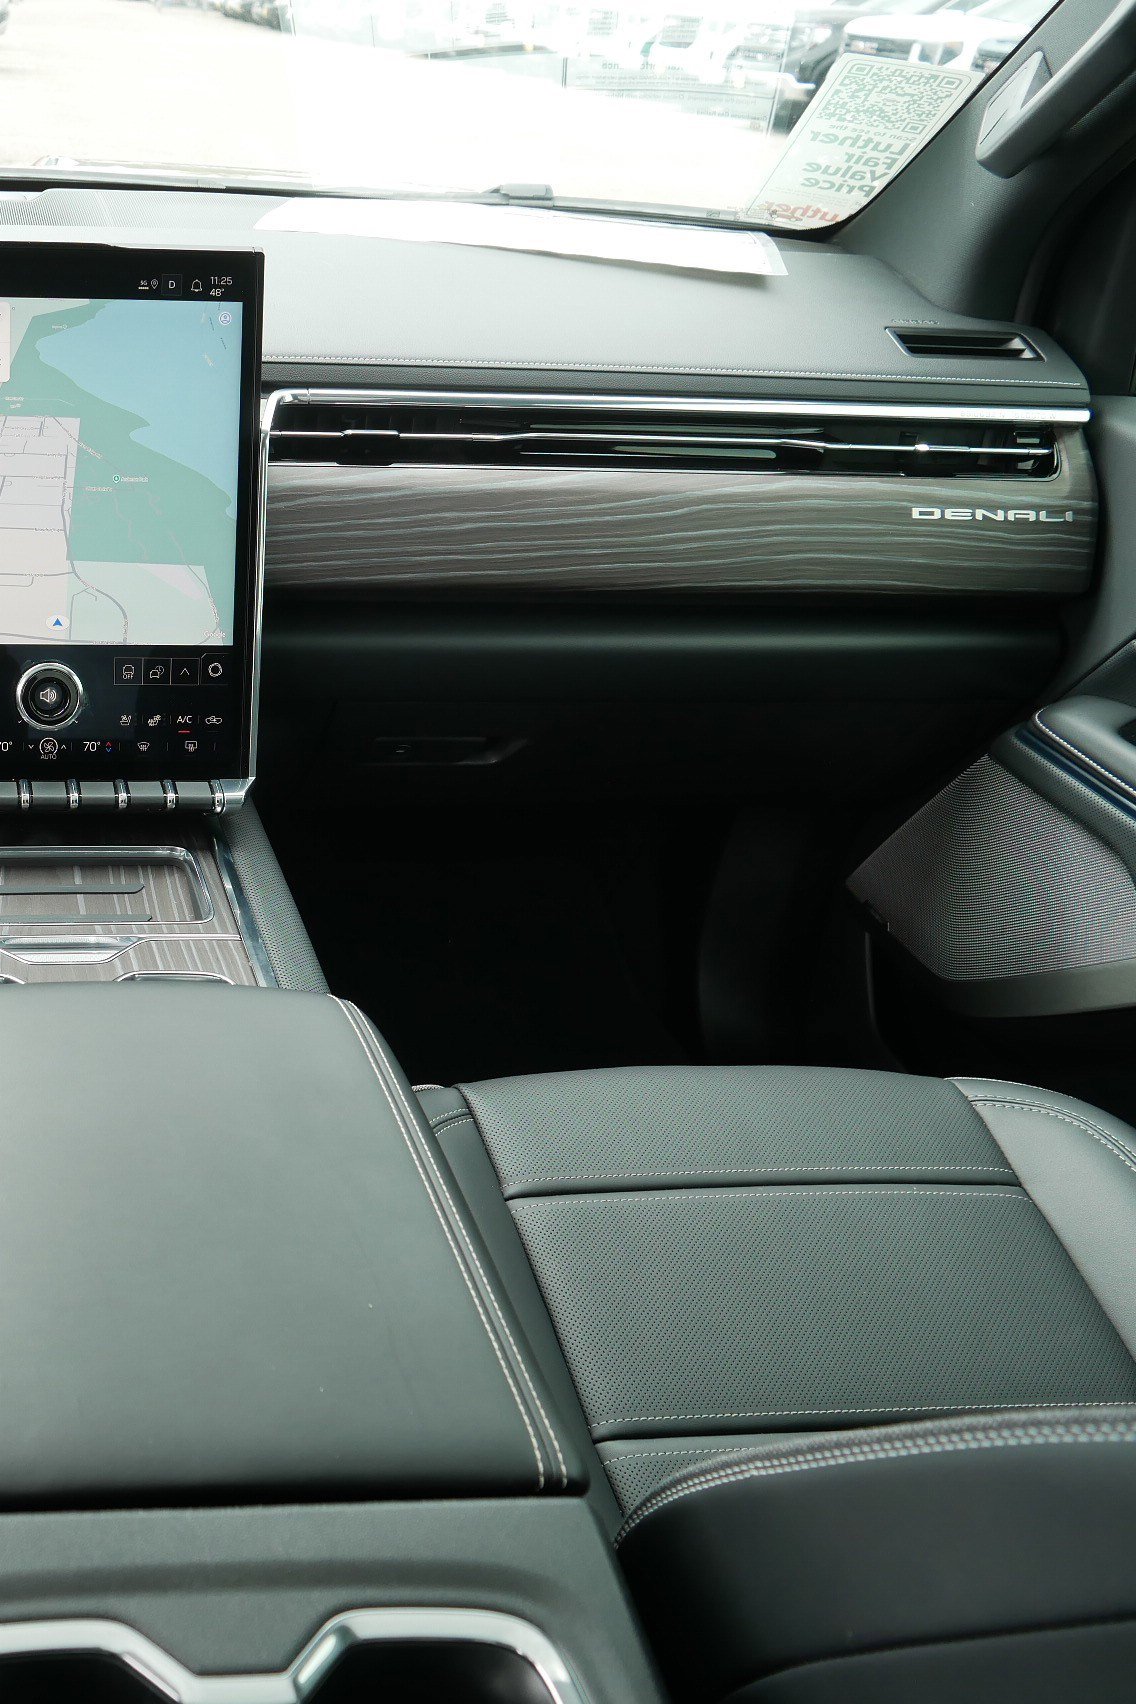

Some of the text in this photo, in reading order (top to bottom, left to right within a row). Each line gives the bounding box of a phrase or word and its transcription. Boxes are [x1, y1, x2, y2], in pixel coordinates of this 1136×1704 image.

[210, 276, 233, 285] 11:25
[912, 507, 1074, 522] DENALI
[177, 715, 193, 724] A/C
